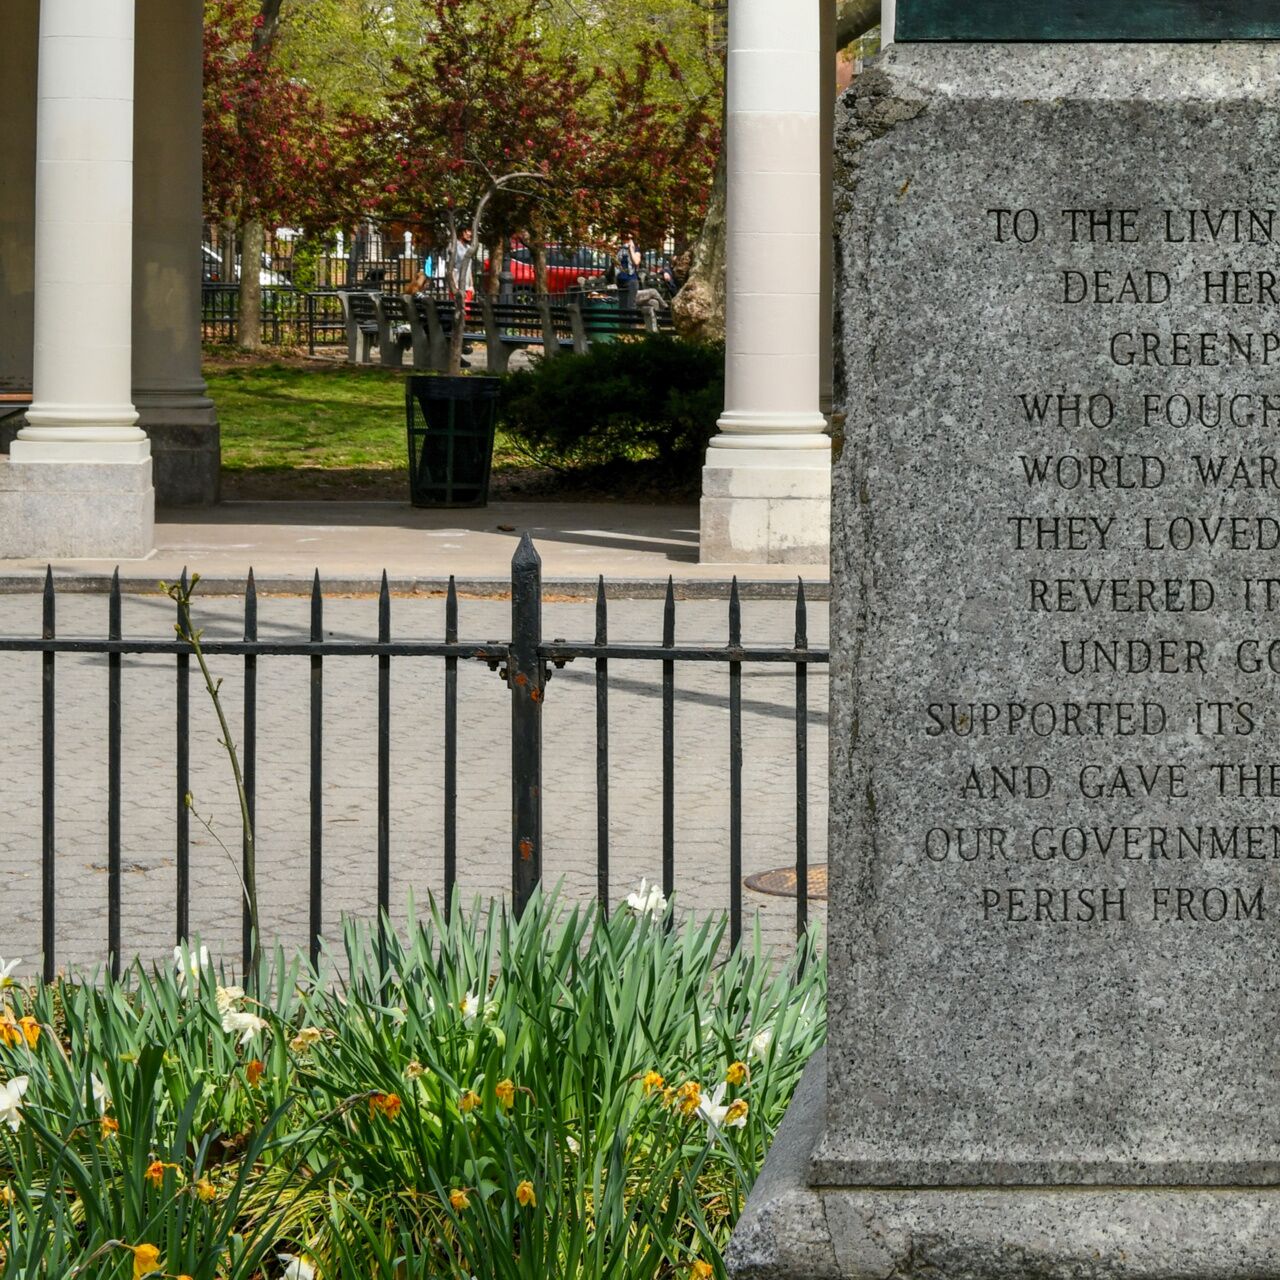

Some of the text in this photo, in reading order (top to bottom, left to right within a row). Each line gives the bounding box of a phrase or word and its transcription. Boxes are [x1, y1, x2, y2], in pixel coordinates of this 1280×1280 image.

[987, 208, 1038, 243] TO
[1062, 209, 1139, 243] THE
[1062, 270, 1171, 304] DEAD
[1018, 393, 1114, 428] WHO
[1018, 455, 1166, 489] WORLD
[1192, 455, 1280, 490] WAR
[1007, 516, 1116, 551] THEY
[1144, 516, 1280, 551] LOVED
[1028, 578, 1216, 613] REVERED
[1061, 640, 1208, 675] UNDER
[925, 702, 1167, 737] SUPPORTED
[960, 765, 1051, 799] AND
[1078, 764, 1188, 799] GAVE
[925, 827, 1008, 862] OUR
[981, 888, 1126, 922] PERISH
[1152, 887, 1265, 922] FROM
